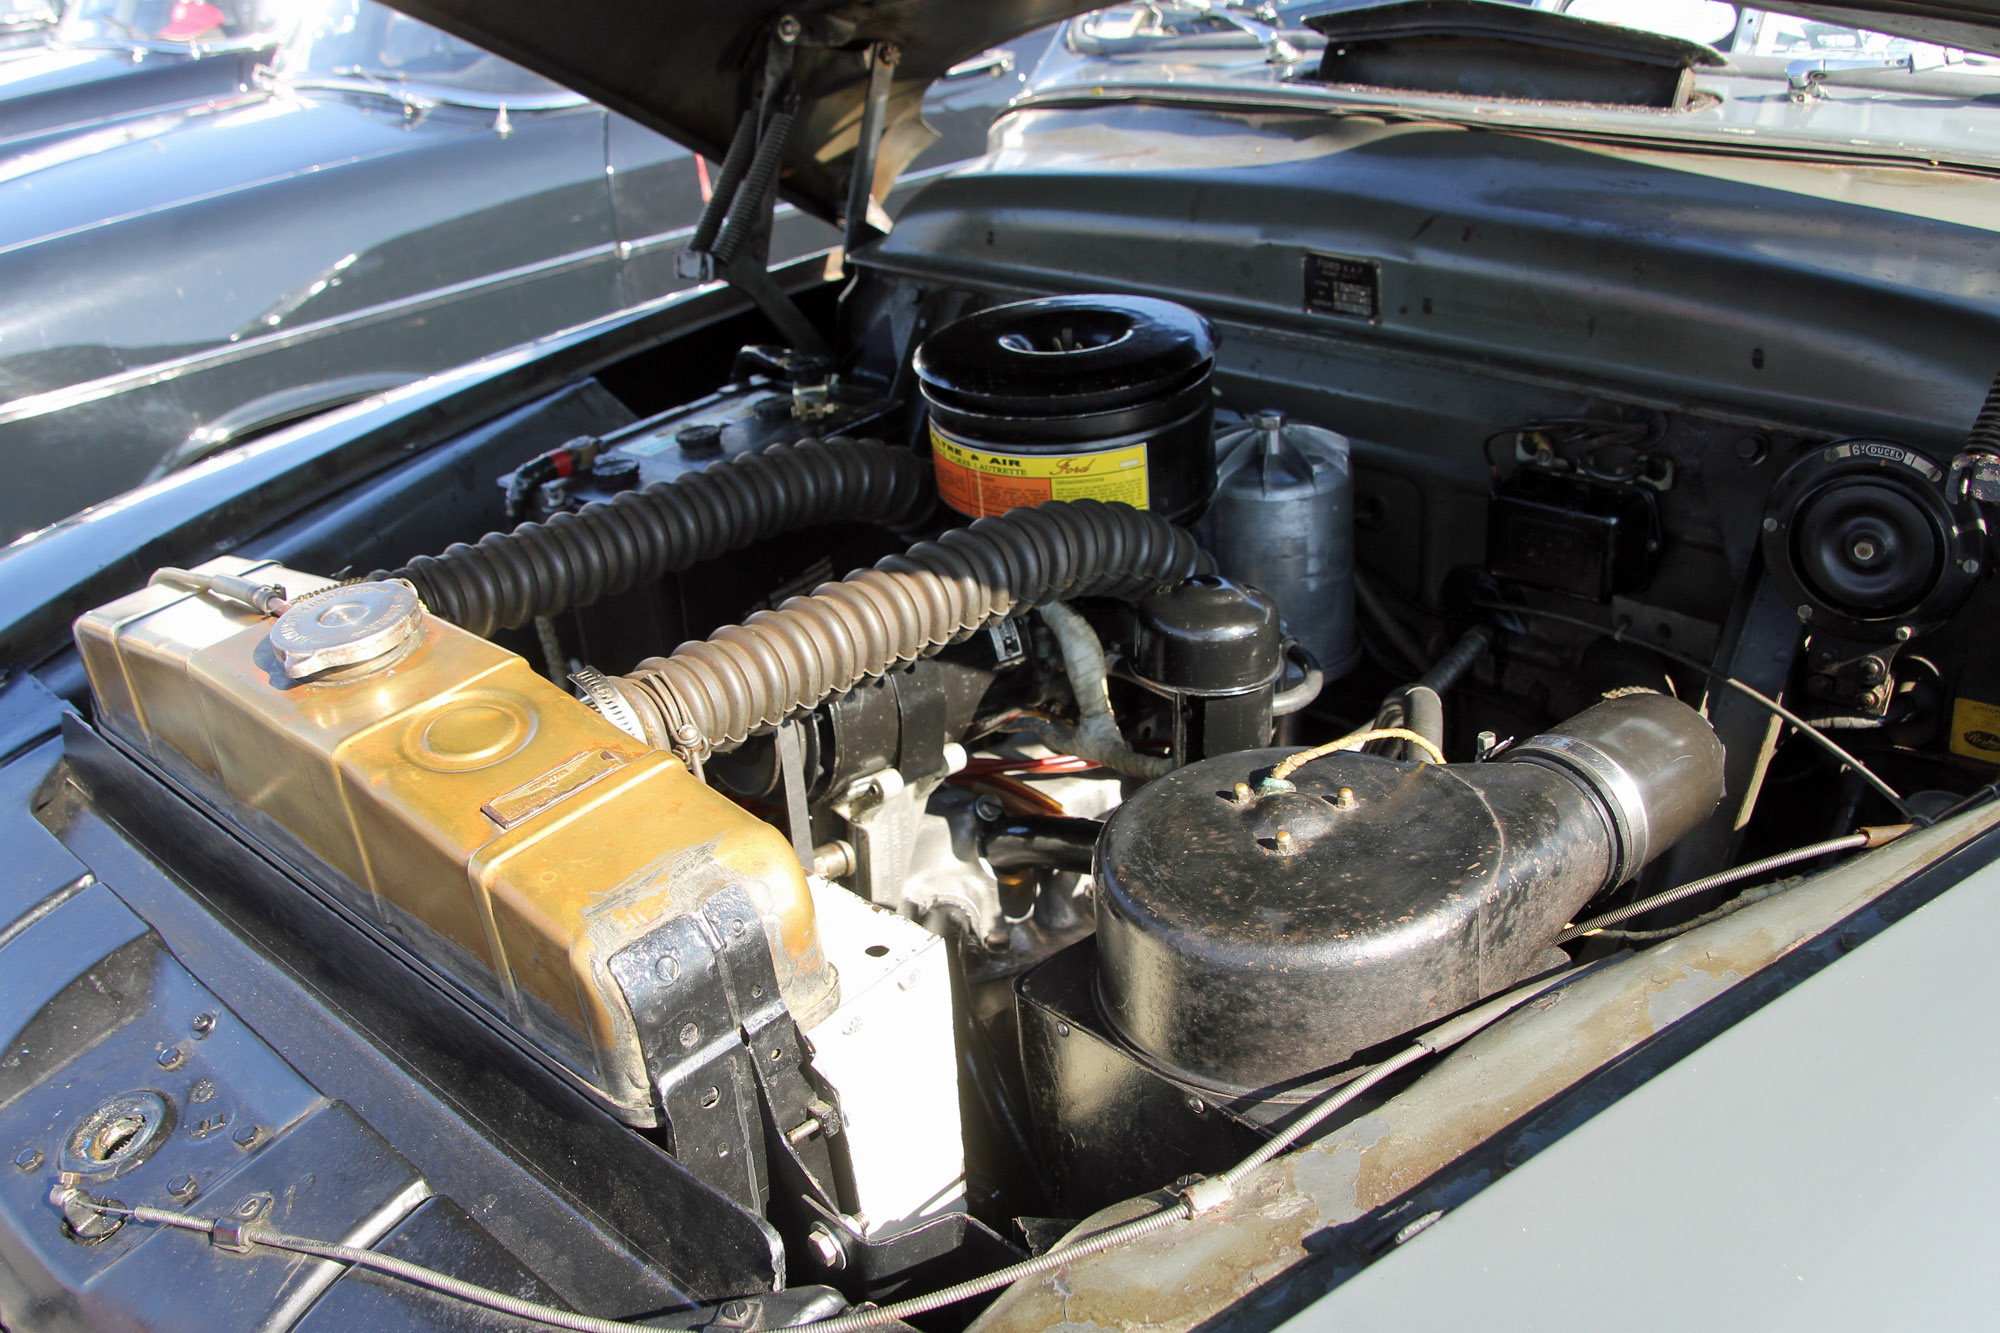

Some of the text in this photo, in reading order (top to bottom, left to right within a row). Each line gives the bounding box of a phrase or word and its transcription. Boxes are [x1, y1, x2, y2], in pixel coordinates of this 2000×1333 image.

[1870, 446, 1901, 459] DUCEL
[990, 457, 1022, 468] AIR
[1050, 458, 1096, 475] Ford
